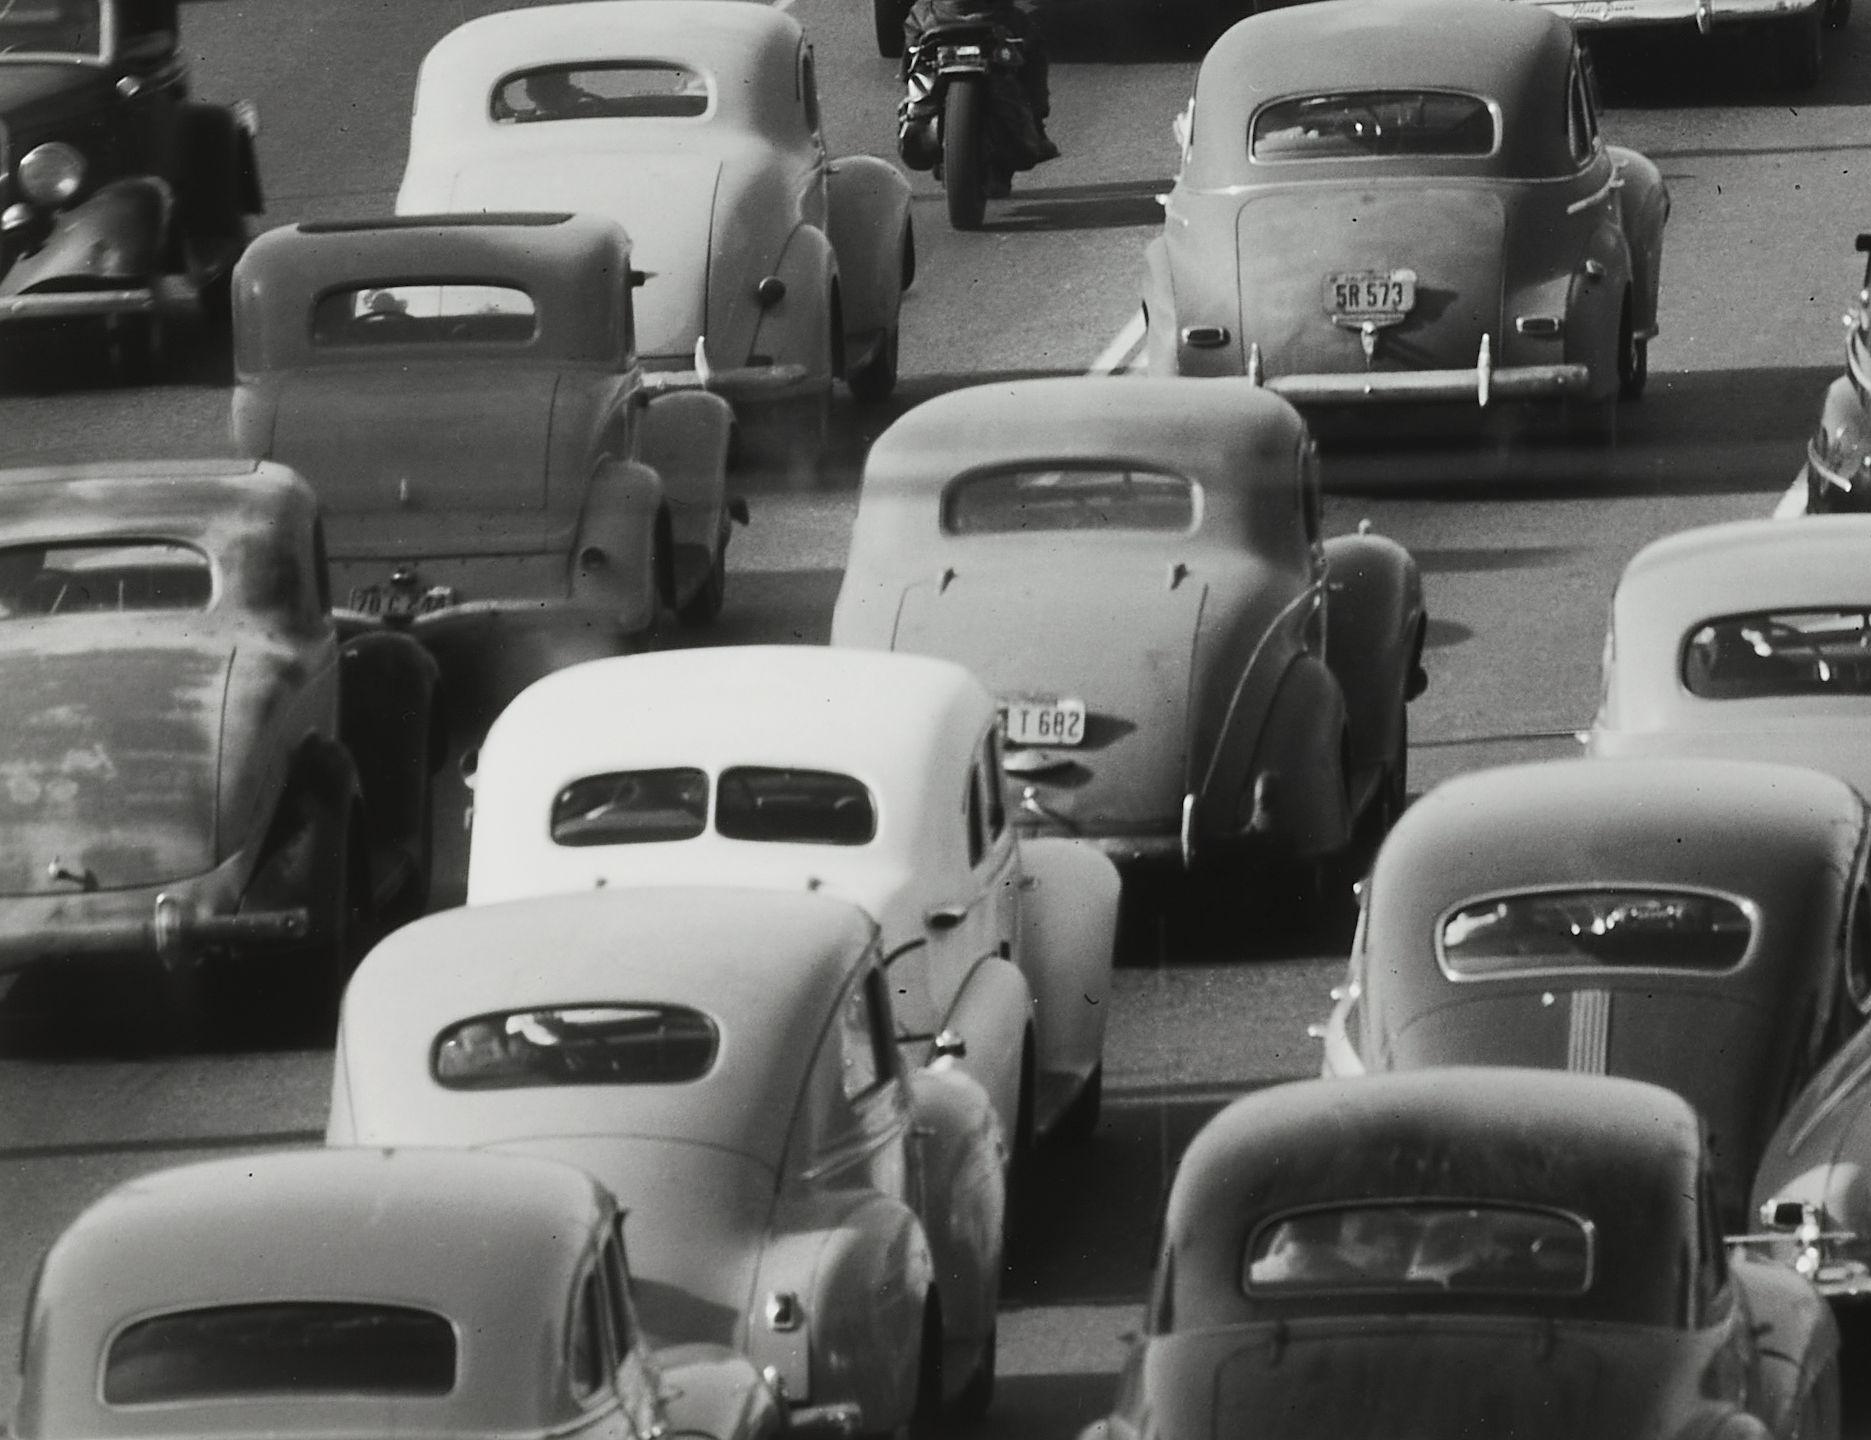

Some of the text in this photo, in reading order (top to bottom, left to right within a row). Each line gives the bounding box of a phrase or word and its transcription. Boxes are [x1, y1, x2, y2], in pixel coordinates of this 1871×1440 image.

[1336, 281, 1403, 307] 5R 573
[1020, 709, 1080, 738] T 682
